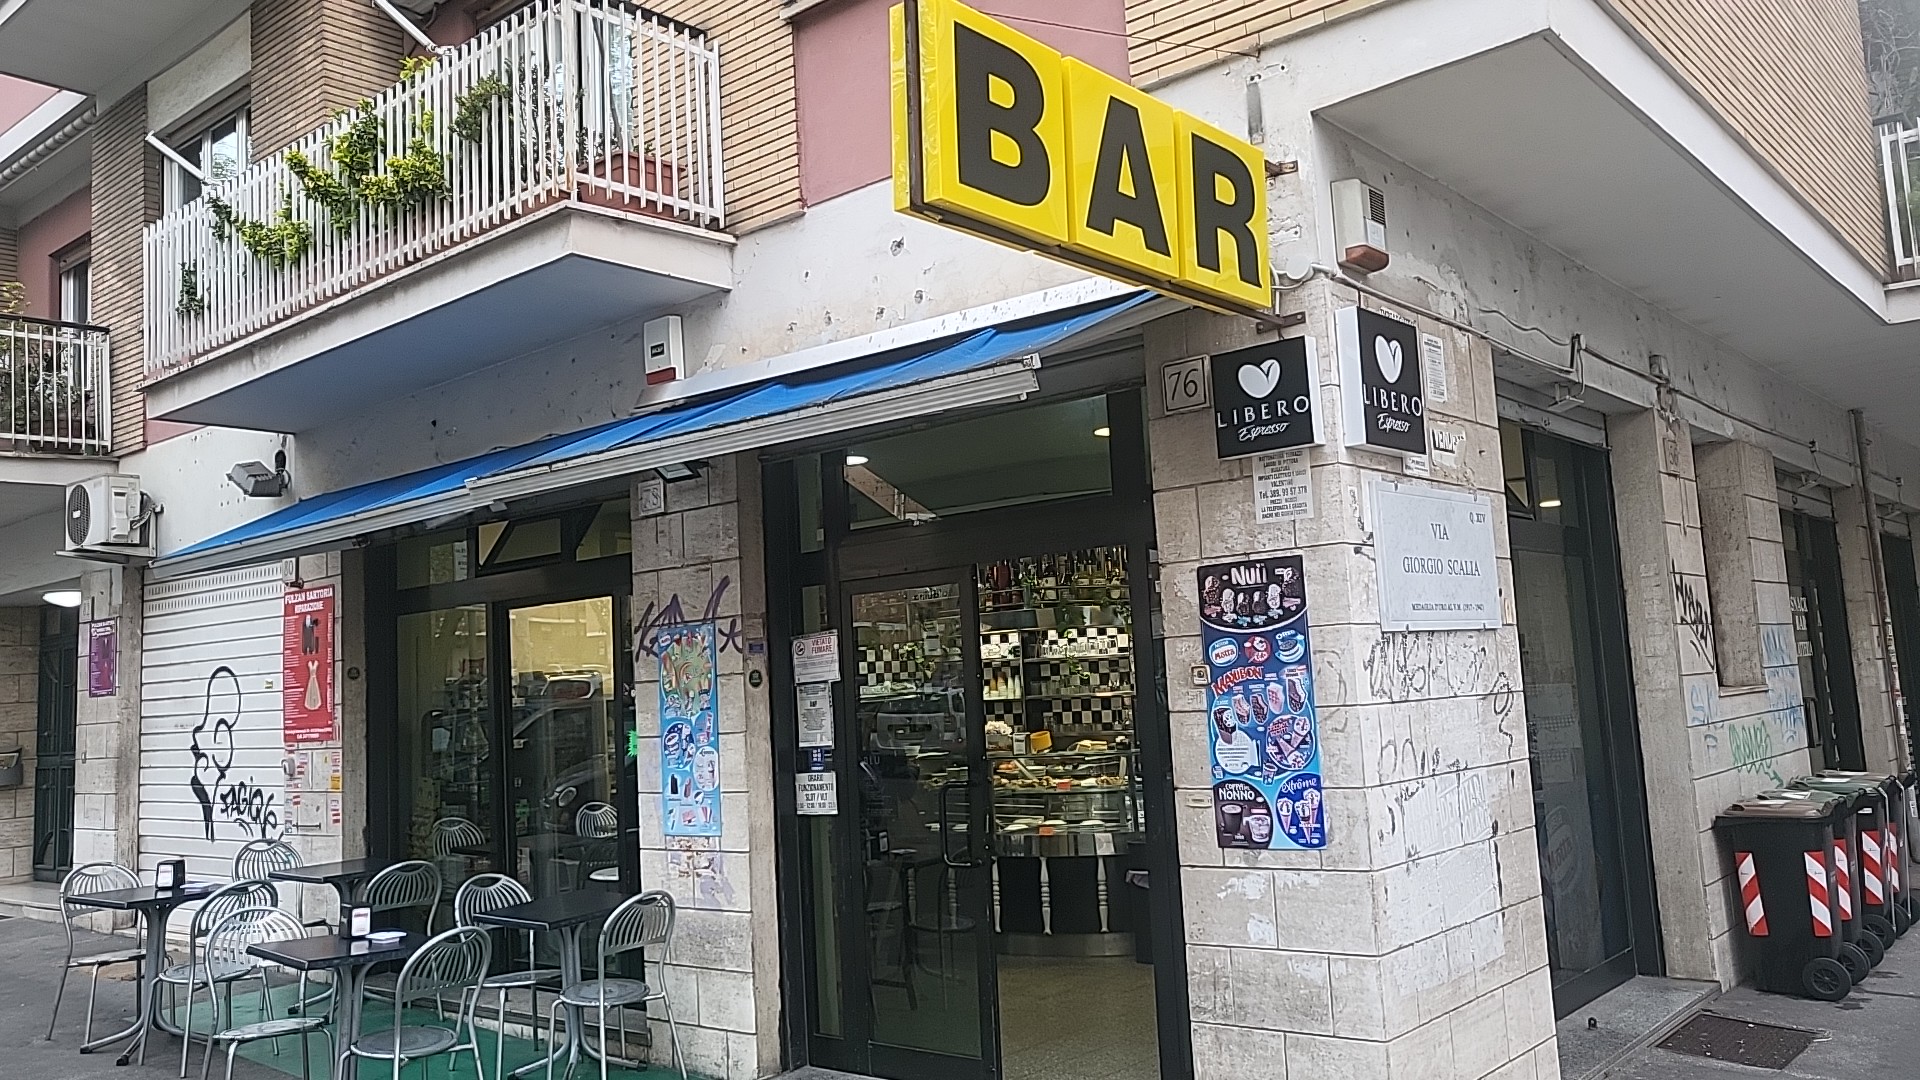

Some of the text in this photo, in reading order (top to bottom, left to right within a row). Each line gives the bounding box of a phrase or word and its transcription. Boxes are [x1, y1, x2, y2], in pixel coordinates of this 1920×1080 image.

[954, 20, 1262, 288] BAR
[1168, 368, 1198, 401] 76
[1363, 383, 1422, 417] LIBERO
[1216, 395, 1310, 428] LIBERO
[1377, 412, 1412, 433] Espresso
[1237, 422, 1291, 442] Espresso
[643, 487, 659, 508] 78
[1475, 513, 1486, 523] XIV
[1430, 523, 1449, 540] VIA
[284, 560, 294, 576] 80
[1402, 556, 1481, 576] GIORGIO SCALIA
[306, 587, 333, 601] SARTORIA
[1790, 596, 1808, 612] SNACK
[1795, 615, 1807, 631] BAR
[811, 637, 832, 646] VIETATO
[811, 645, 833, 654] FUMARE
[1214, 649, 1235, 661] Motta
[1211, 666, 1264, 698] MAXIBON
[798, 783, 833, 792] FUNZIONAMENTO
[1218, 787, 1255, 800] NONNO
[1225, 783, 1244, 791] COPPA
